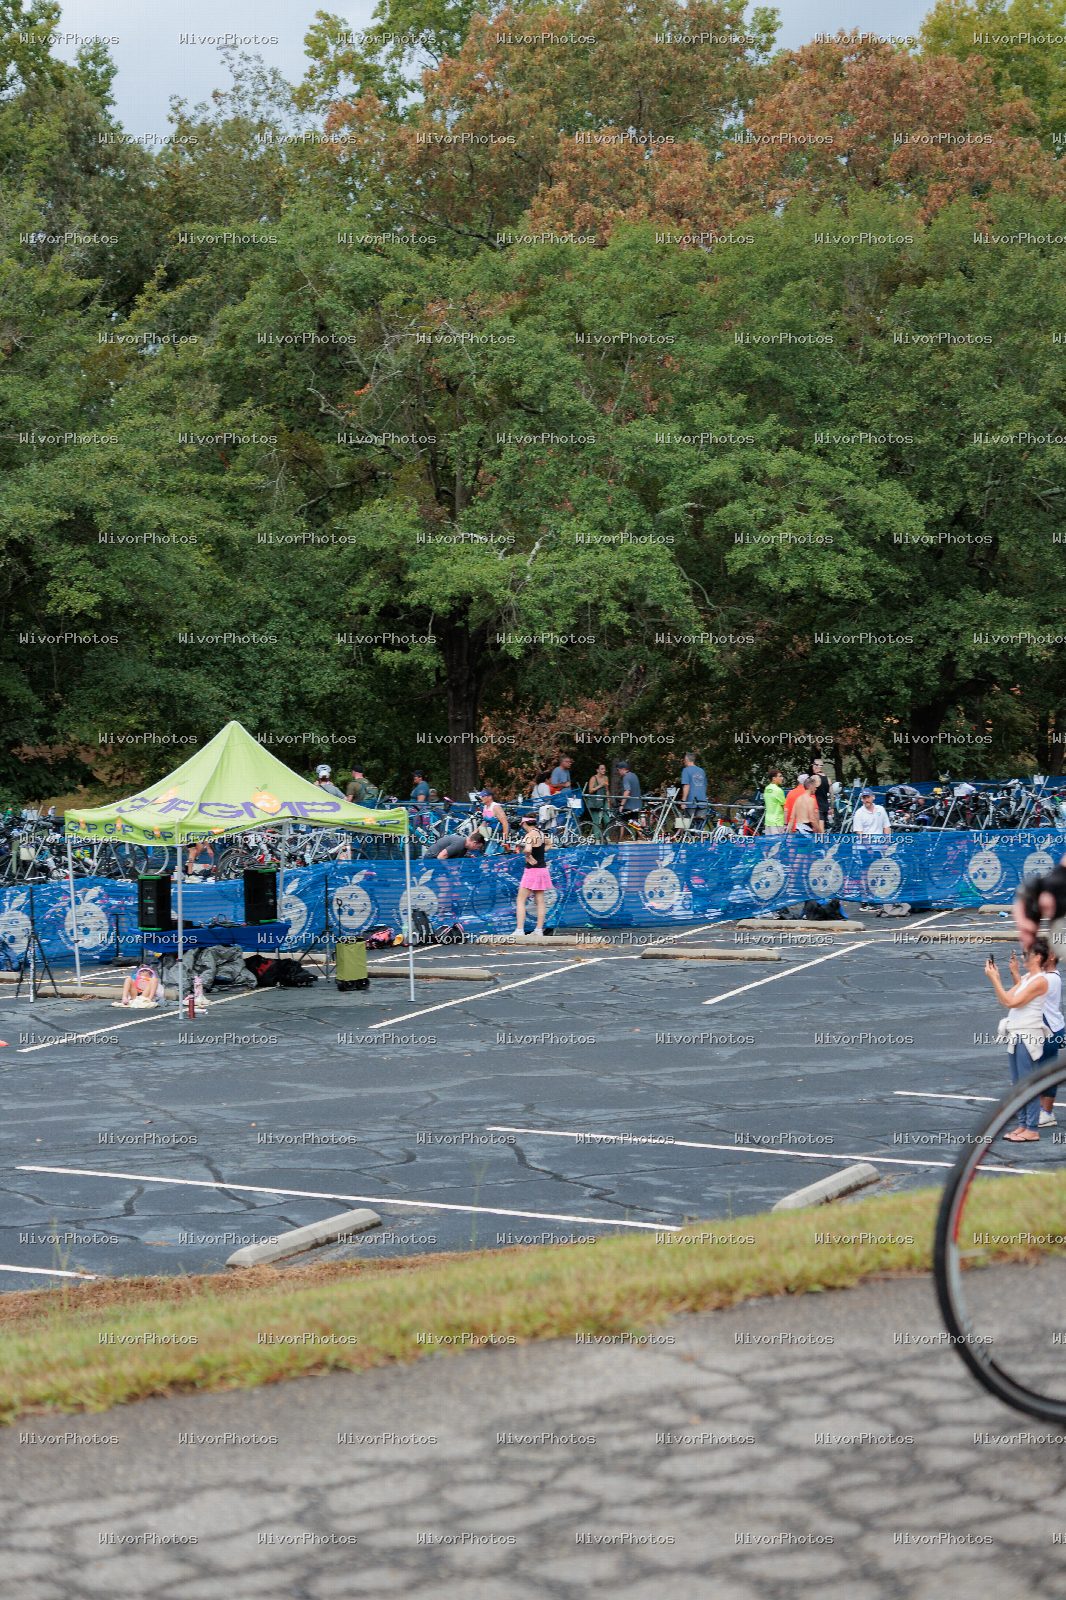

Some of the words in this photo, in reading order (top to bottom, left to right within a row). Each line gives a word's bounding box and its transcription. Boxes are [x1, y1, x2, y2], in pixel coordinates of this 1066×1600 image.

[198, 801, 342, 819] GMP
[67, 820, 98, 833] GP
[104, 823, 134, 834] GP
[143, 829, 174, 841] GP
